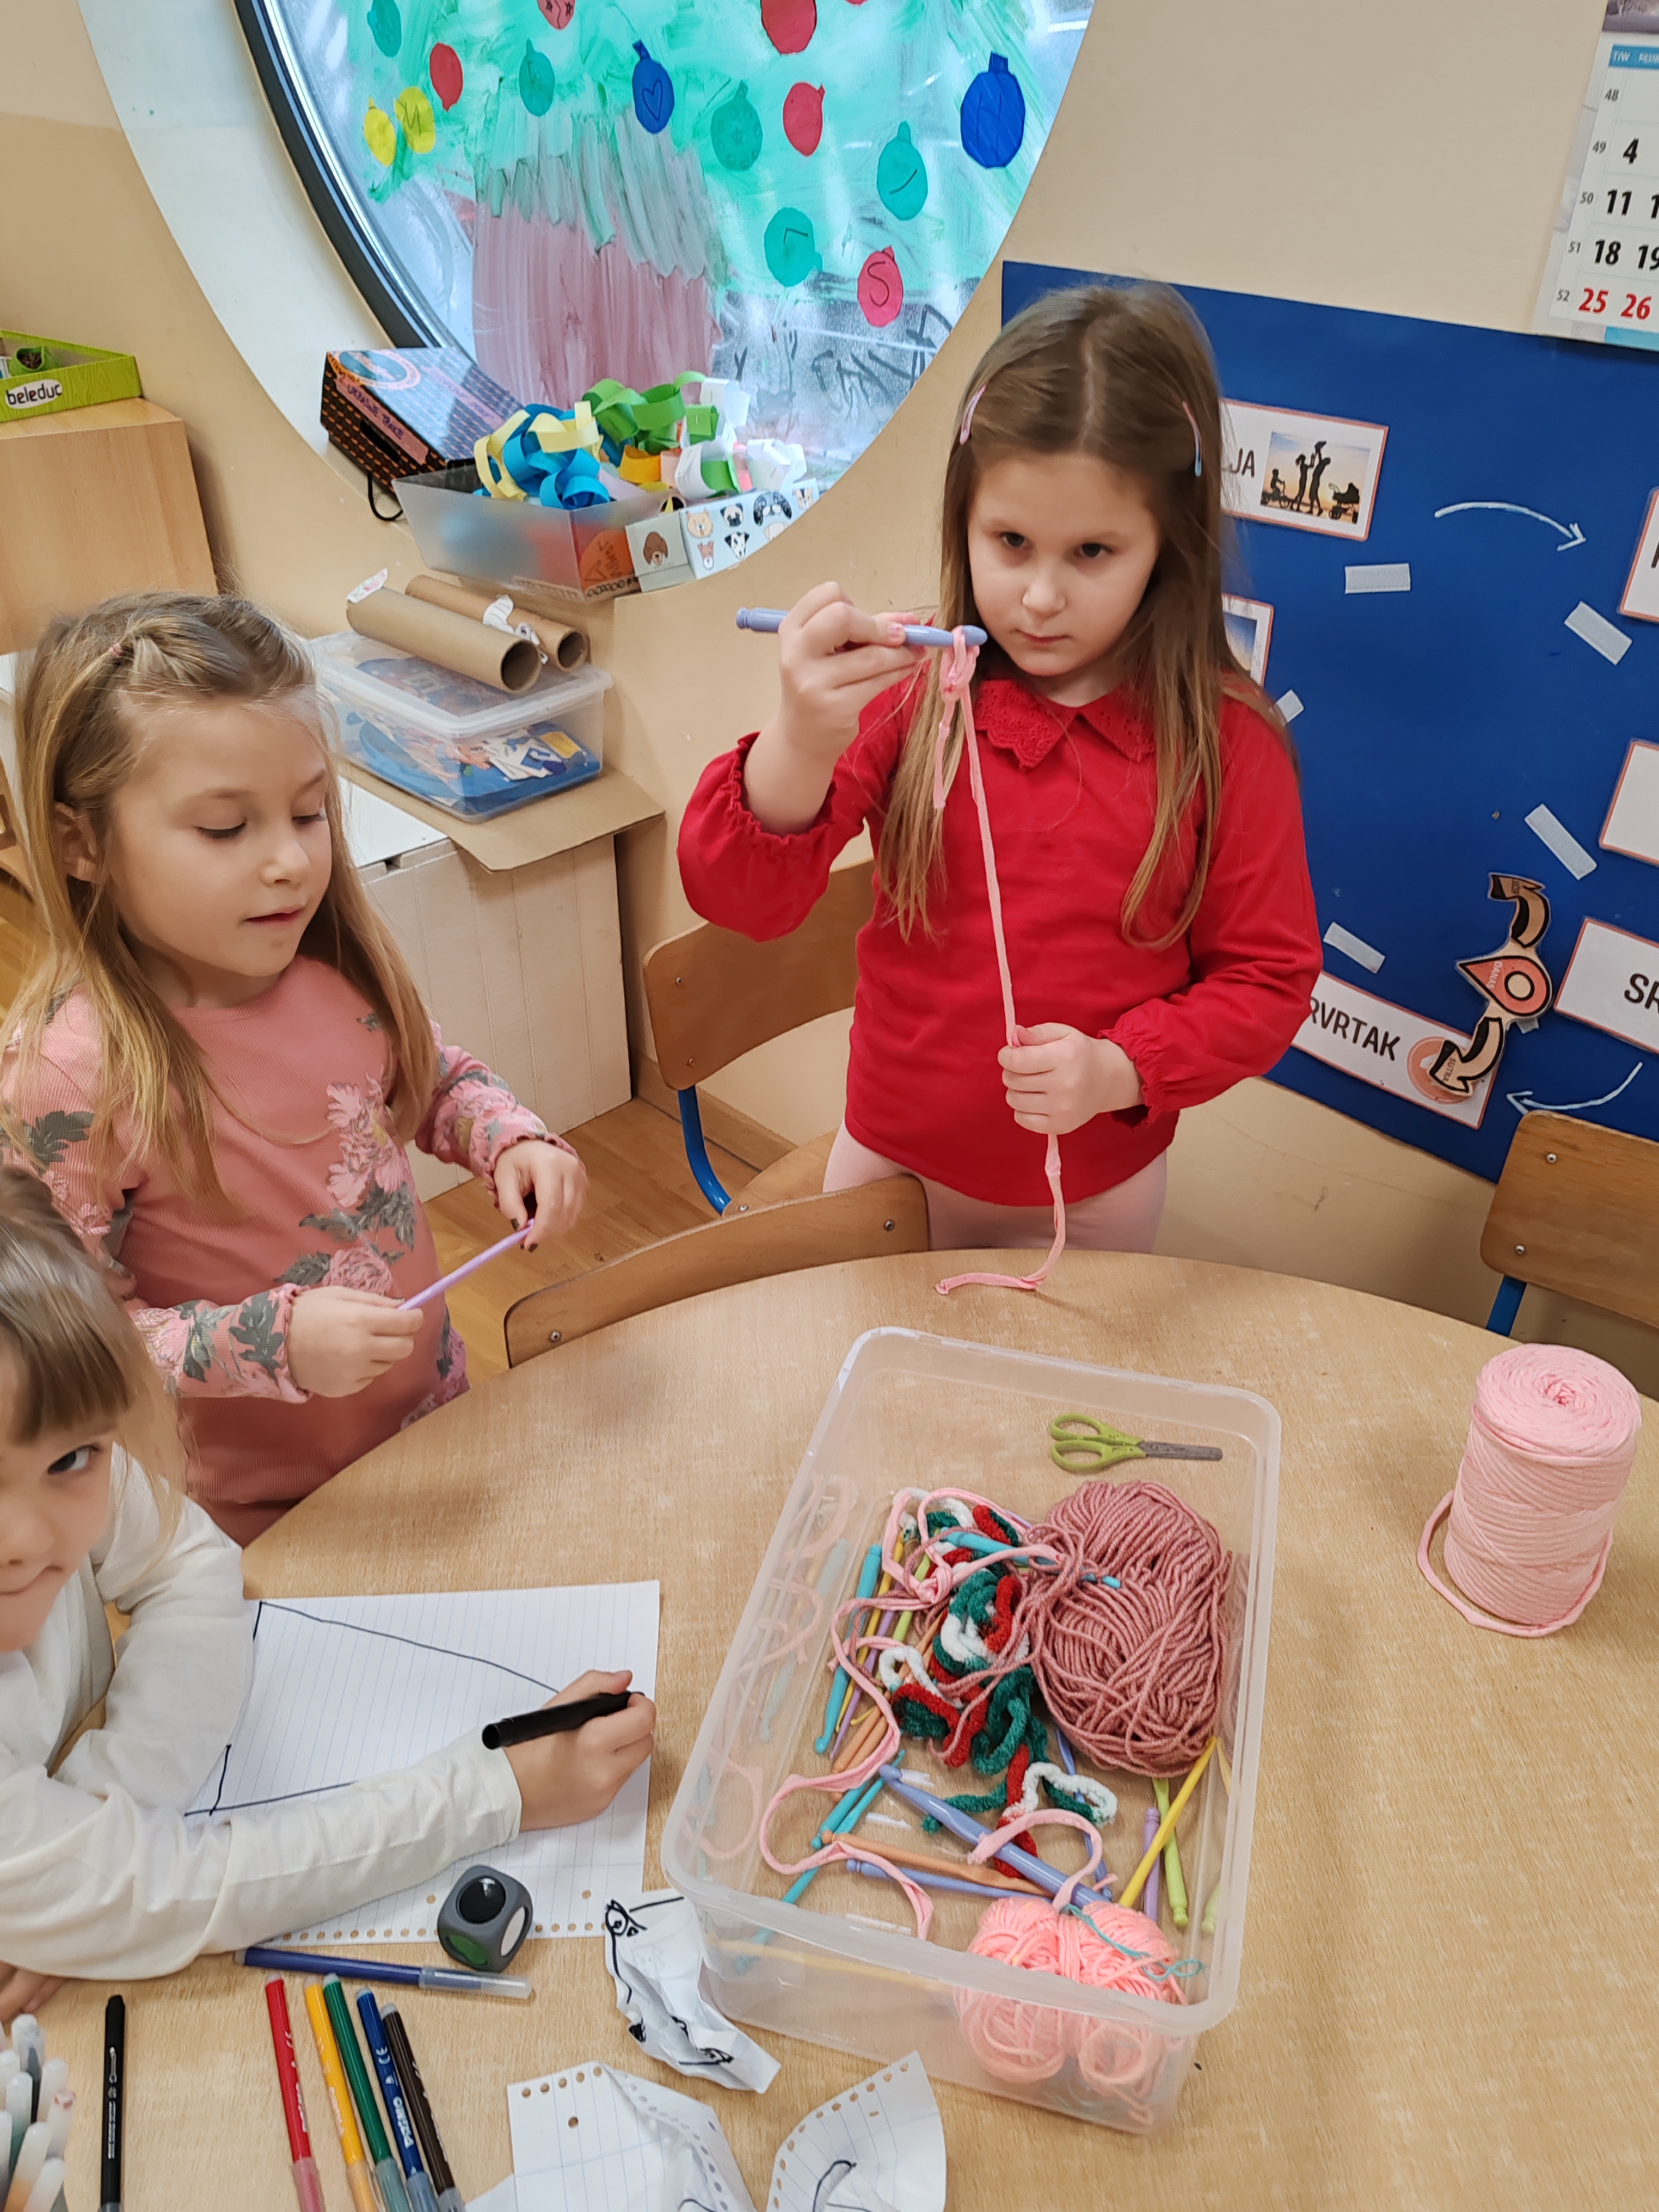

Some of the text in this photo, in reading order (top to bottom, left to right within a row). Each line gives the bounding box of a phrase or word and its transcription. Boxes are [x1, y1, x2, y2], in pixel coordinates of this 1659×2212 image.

[1605, 88, 1619, 102] 48
[1593, 138, 1639, 164] 49 4
[1580, 191, 1594, 205] 50
[1607, 188, 1632, 216] 11
[1568, 239, 1659, 271] 51 18 19
[1557, 287, 1652, 320] 52 25 26
[5, 383, 63, 405] beleduc
[1487, 961, 1503, 990] DANAS
[1443, 1057, 1457, 1082] SUTRA
